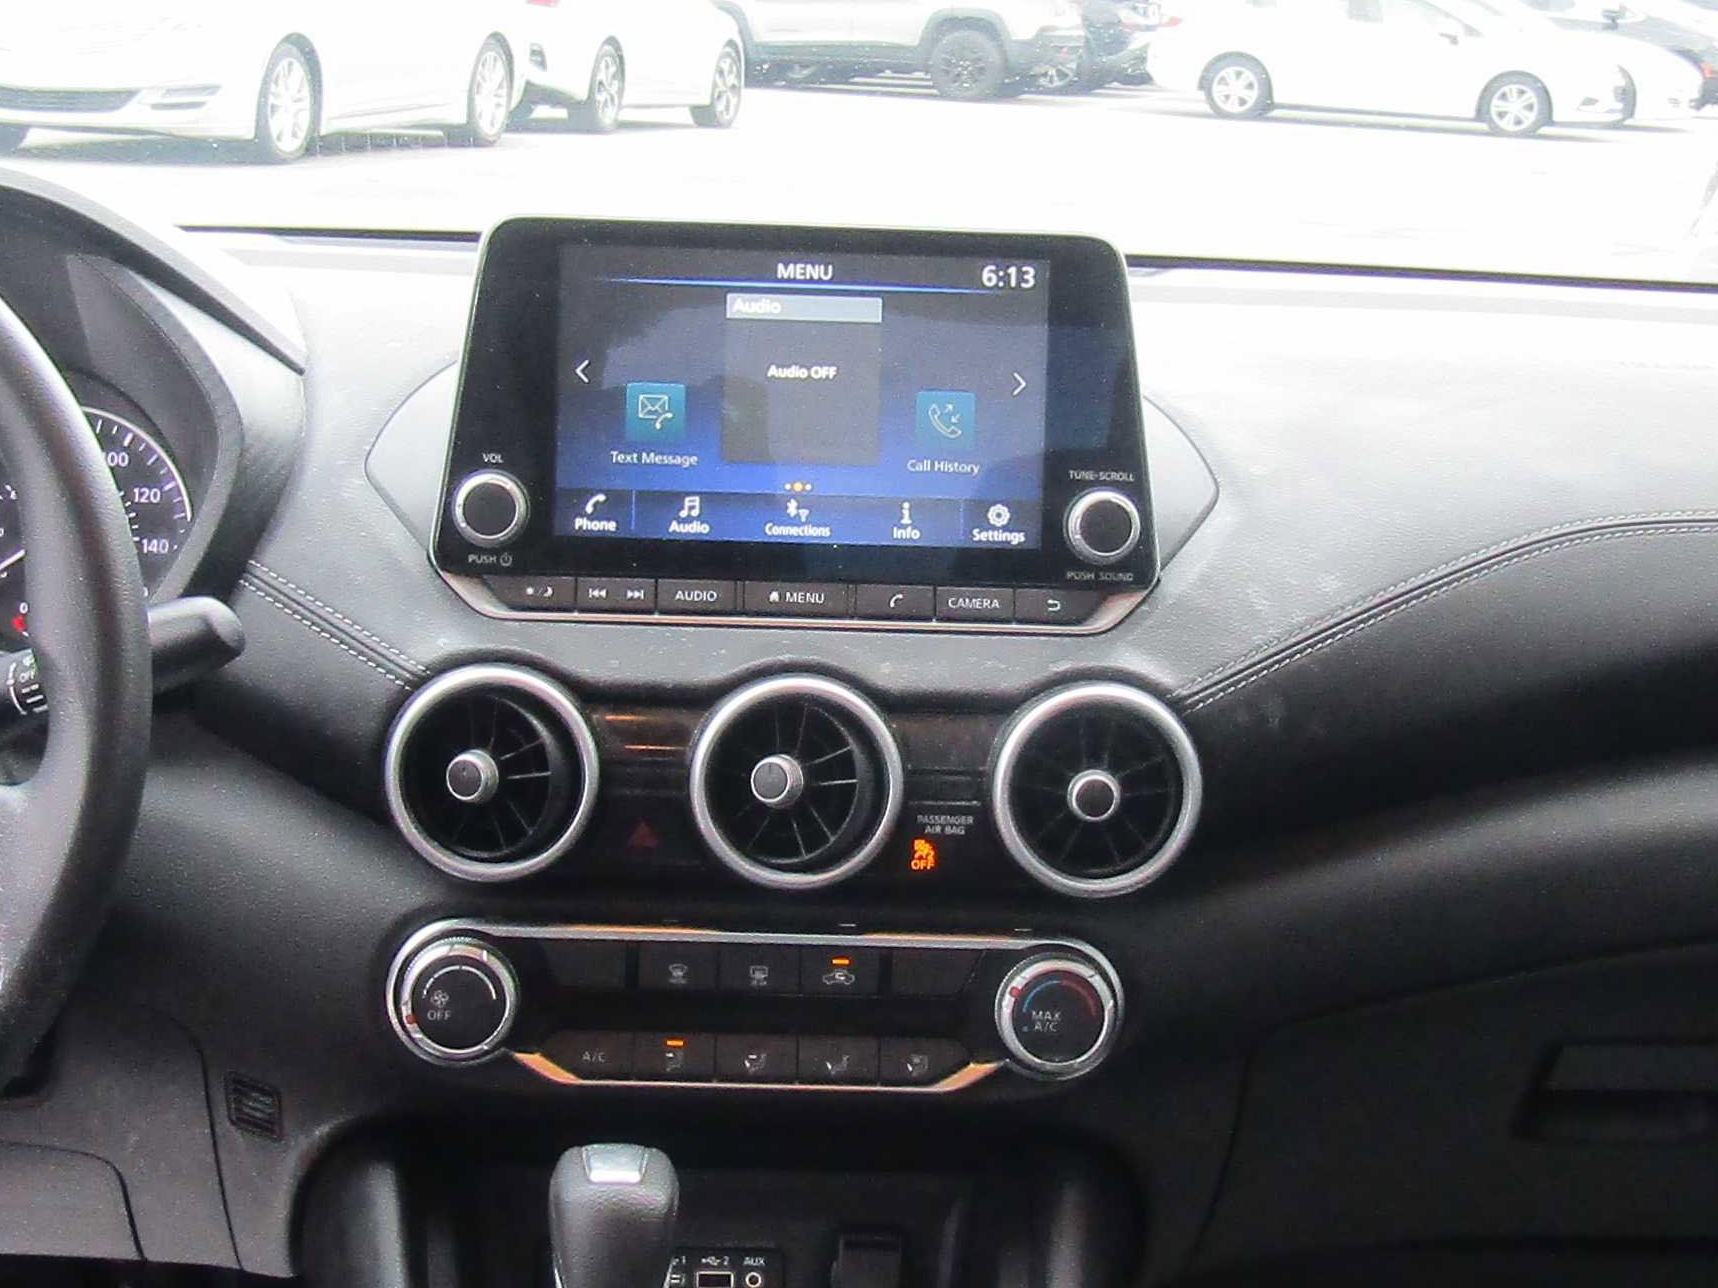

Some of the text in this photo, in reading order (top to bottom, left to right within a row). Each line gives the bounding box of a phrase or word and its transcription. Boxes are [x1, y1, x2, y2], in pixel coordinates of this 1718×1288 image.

[776, 263, 833, 280] MENU
[980, 265, 1036, 288] 6:13
[732, 298, 782, 314] Audio
[767, 366, 837, 380] Audio OFF
[106, 451, 130, 467] 00
[482, 452, 504, 464] VOL
[610, 451, 699, 468] Text Message
[907, 459, 980, 477] Call History
[132, 487, 161, 504] 120
[574, 517, 617, 532] Phone
[668, 520, 710, 534] Audio
[764, 523, 831, 538] Connections
[892, 526, 921, 541] Info
[971, 527, 1026, 545] Settings
[141, 538, 169, 554] 140
[467, 553, 497, 565] PUSH
[675, 589, 717, 602] AUDIO
[784, 591, 825, 605] MENU
[948, 596, 1000, 610] CAMERA
[916, 814, 974, 825] PASSENGER
[910, 858, 935, 870] OFF
[426, 1009, 452, 1021] OFF
[1031, 1010, 1061, 1022] MAX
[1034, 1021, 1058, 1033] A/C
[582, 1050, 606, 1063] A/C
[743, 1256, 766, 1267] AUX
